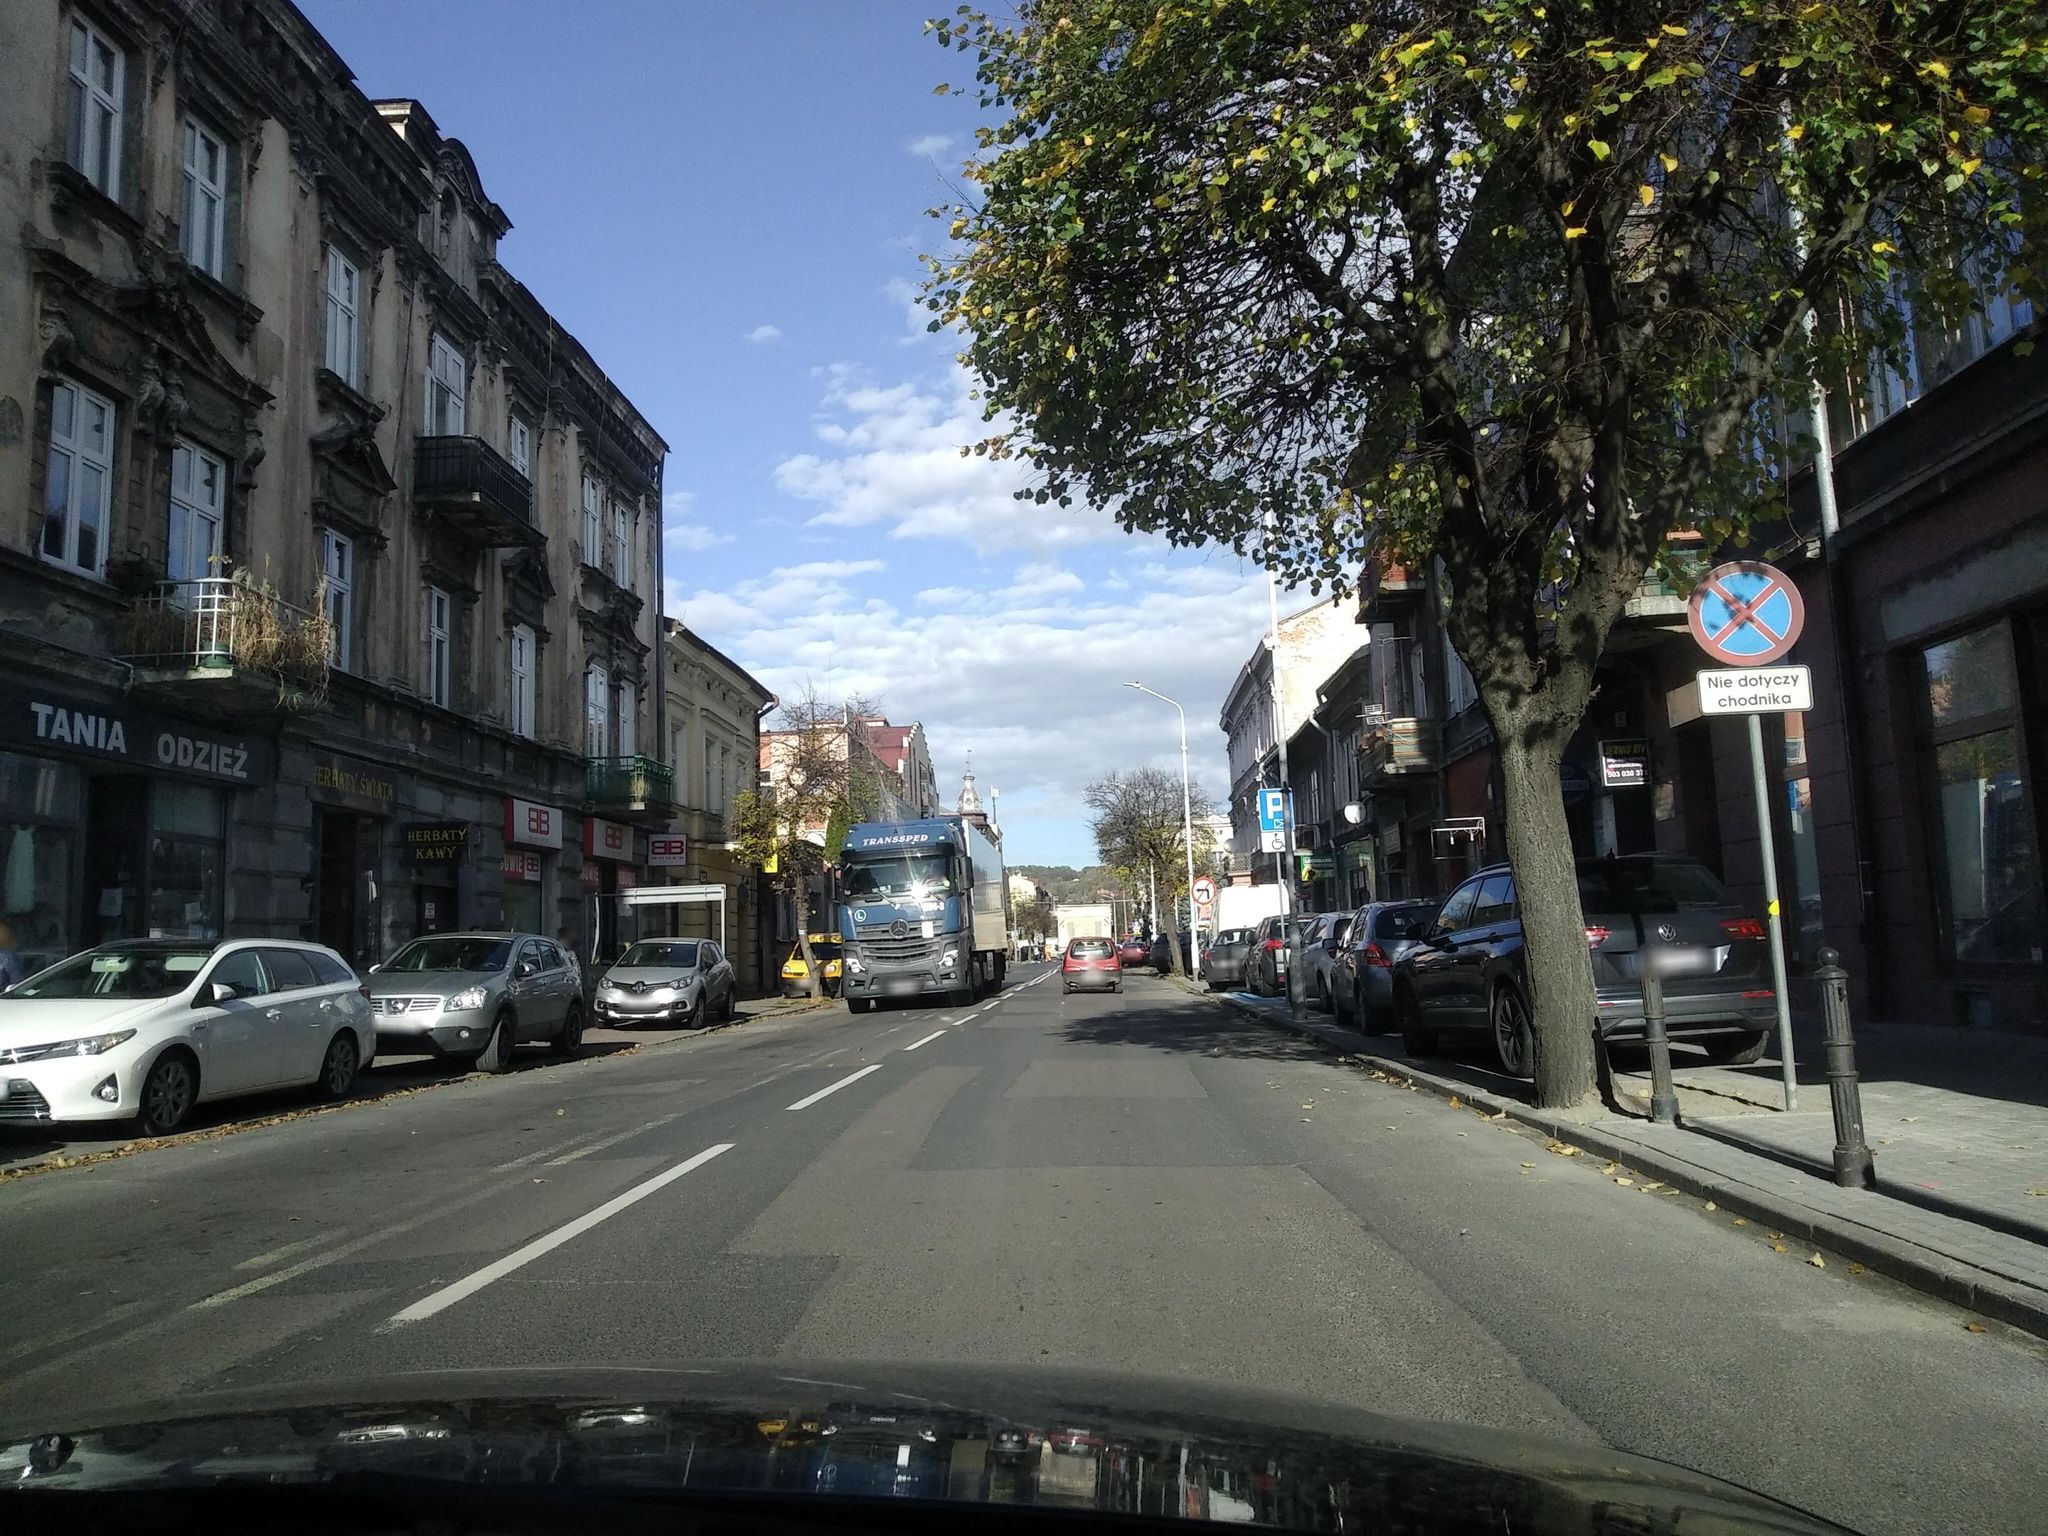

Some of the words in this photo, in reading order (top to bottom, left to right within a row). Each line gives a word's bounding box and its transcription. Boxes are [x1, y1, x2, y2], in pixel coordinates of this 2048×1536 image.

[1707, 676, 1733, 689] Nie
[1738, 674, 1800, 689] dotyczy
[1717, 692, 1792, 707] chodnika
[31, 702, 127, 754] TANIA
[157, 732, 249, 779] ODZIEŻ
[1608, 770, 1620, 779] 503
[1266, 792, 1284, 820] P
[407, 827, 467, 843] HERBATY
[862, 833, 930, 848] TRANSSPED
[416, 846, 457, 860] KAWY
